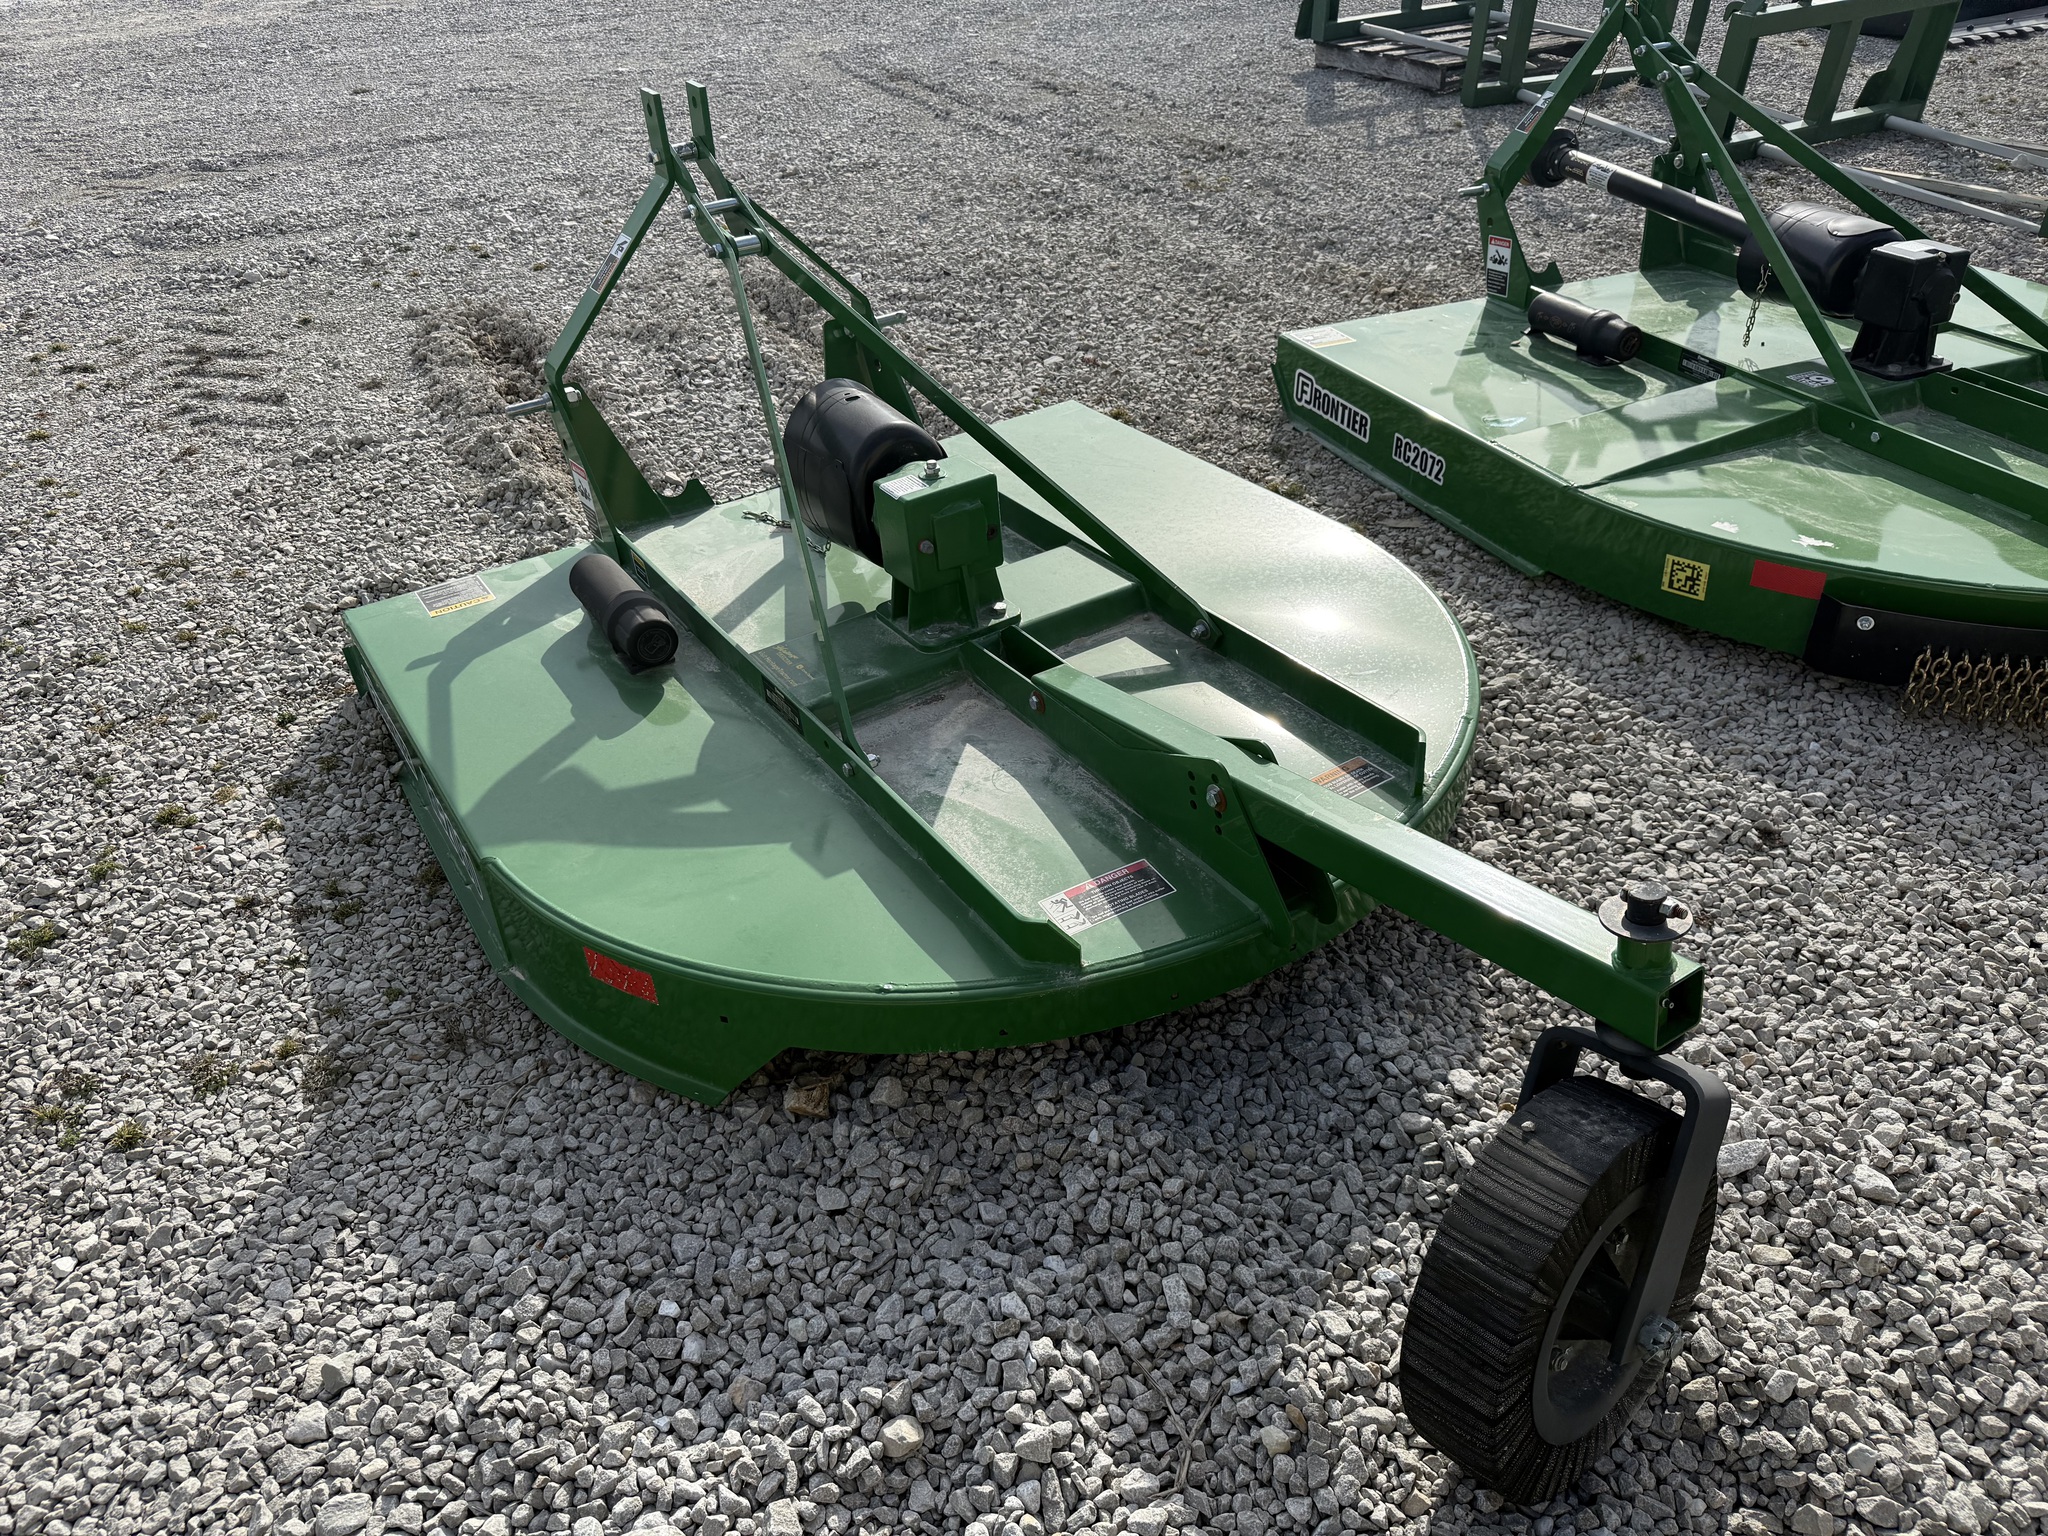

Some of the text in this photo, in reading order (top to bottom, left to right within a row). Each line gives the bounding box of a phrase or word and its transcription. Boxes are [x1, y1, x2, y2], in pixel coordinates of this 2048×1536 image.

[1393, 435, 1444, 484] RC2072
[435, 598, 479, 615] CAUTION
[1093, 868, 1130, 886] DANGER
